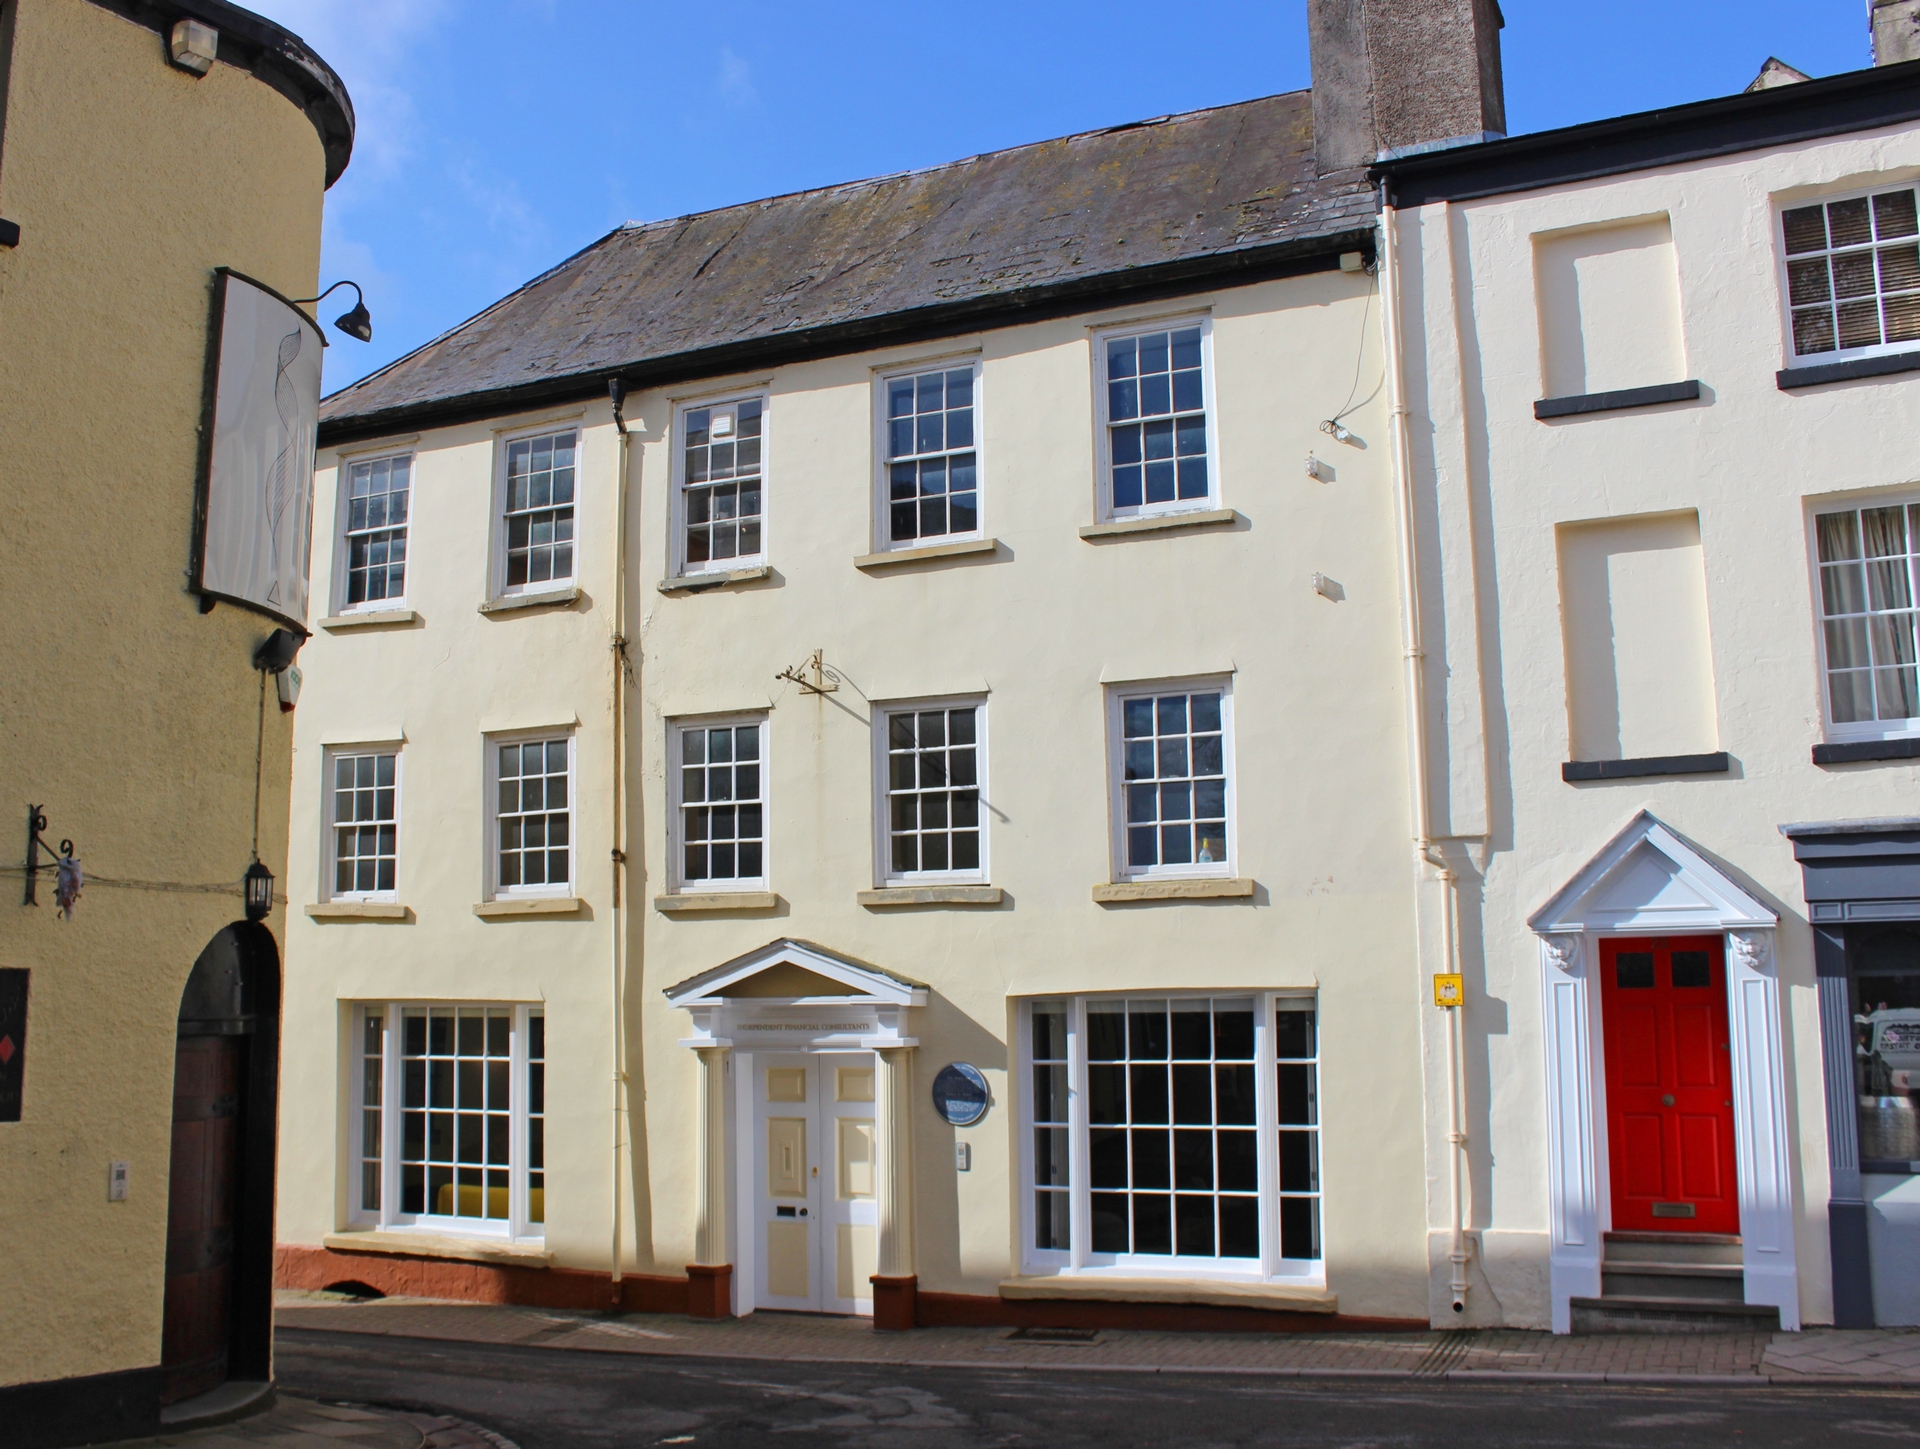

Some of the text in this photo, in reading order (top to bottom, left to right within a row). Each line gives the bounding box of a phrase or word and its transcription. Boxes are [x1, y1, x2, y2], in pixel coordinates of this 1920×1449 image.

[737, 1023, 870, 1031] INDEPENDENT FINANCIAL CONSULTANTS
